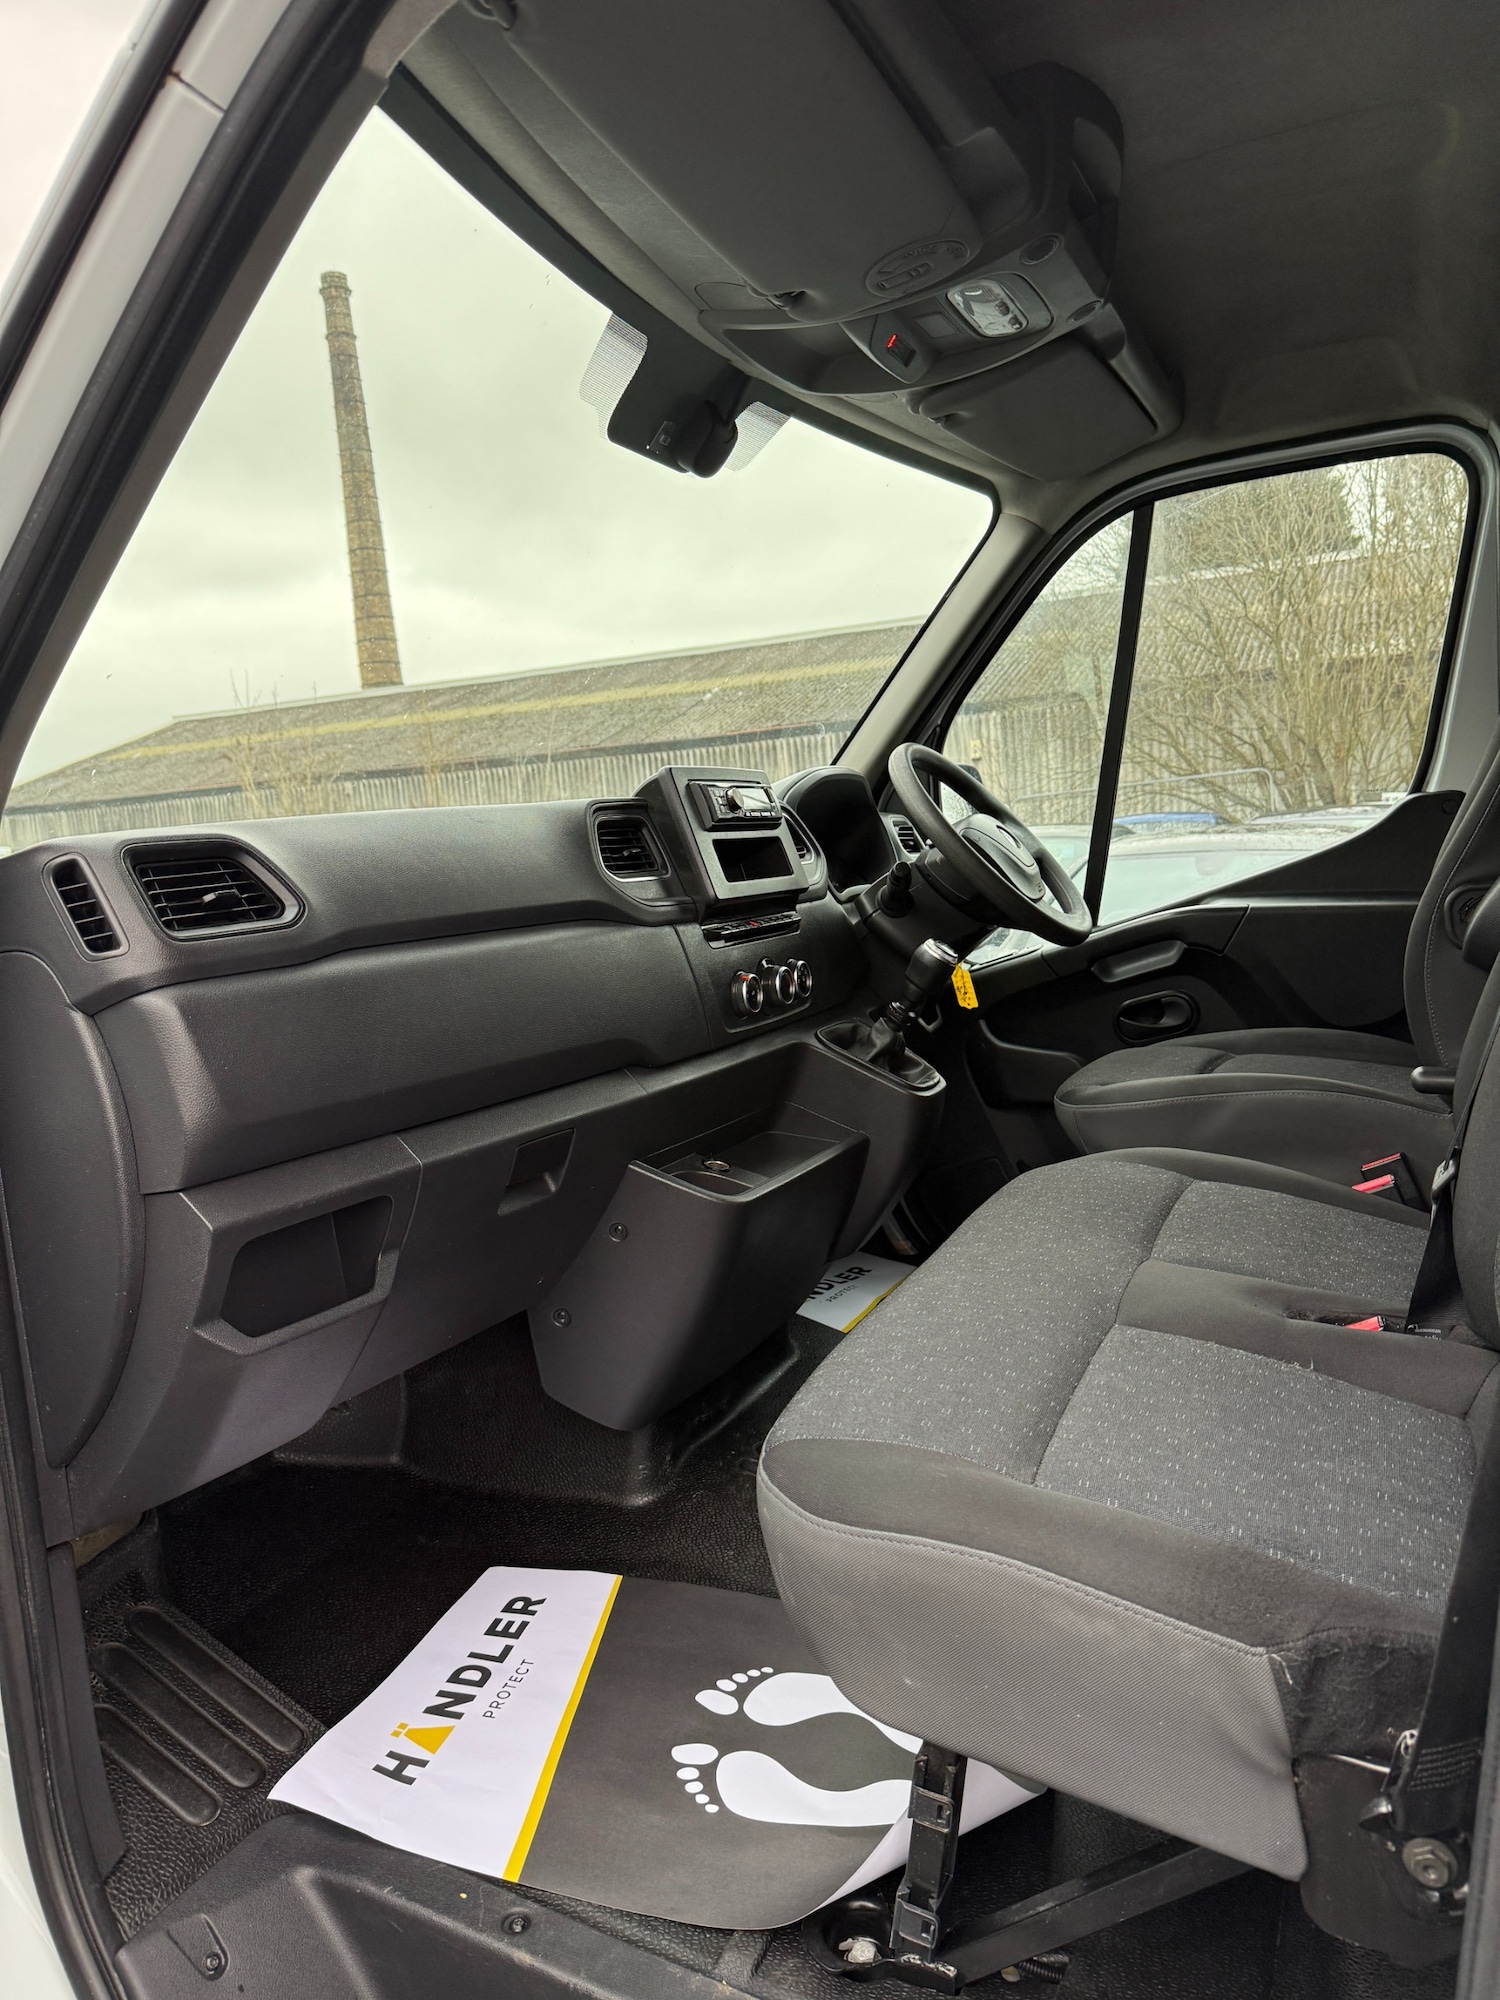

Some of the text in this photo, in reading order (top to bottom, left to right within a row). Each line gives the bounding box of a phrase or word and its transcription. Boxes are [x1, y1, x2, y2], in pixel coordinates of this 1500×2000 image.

[806, 1266, 873, 1300] NDLER
[372, 1596, 547, 1785] HÄNDLER
[482, 1658, 534, 1719] PROTECT
